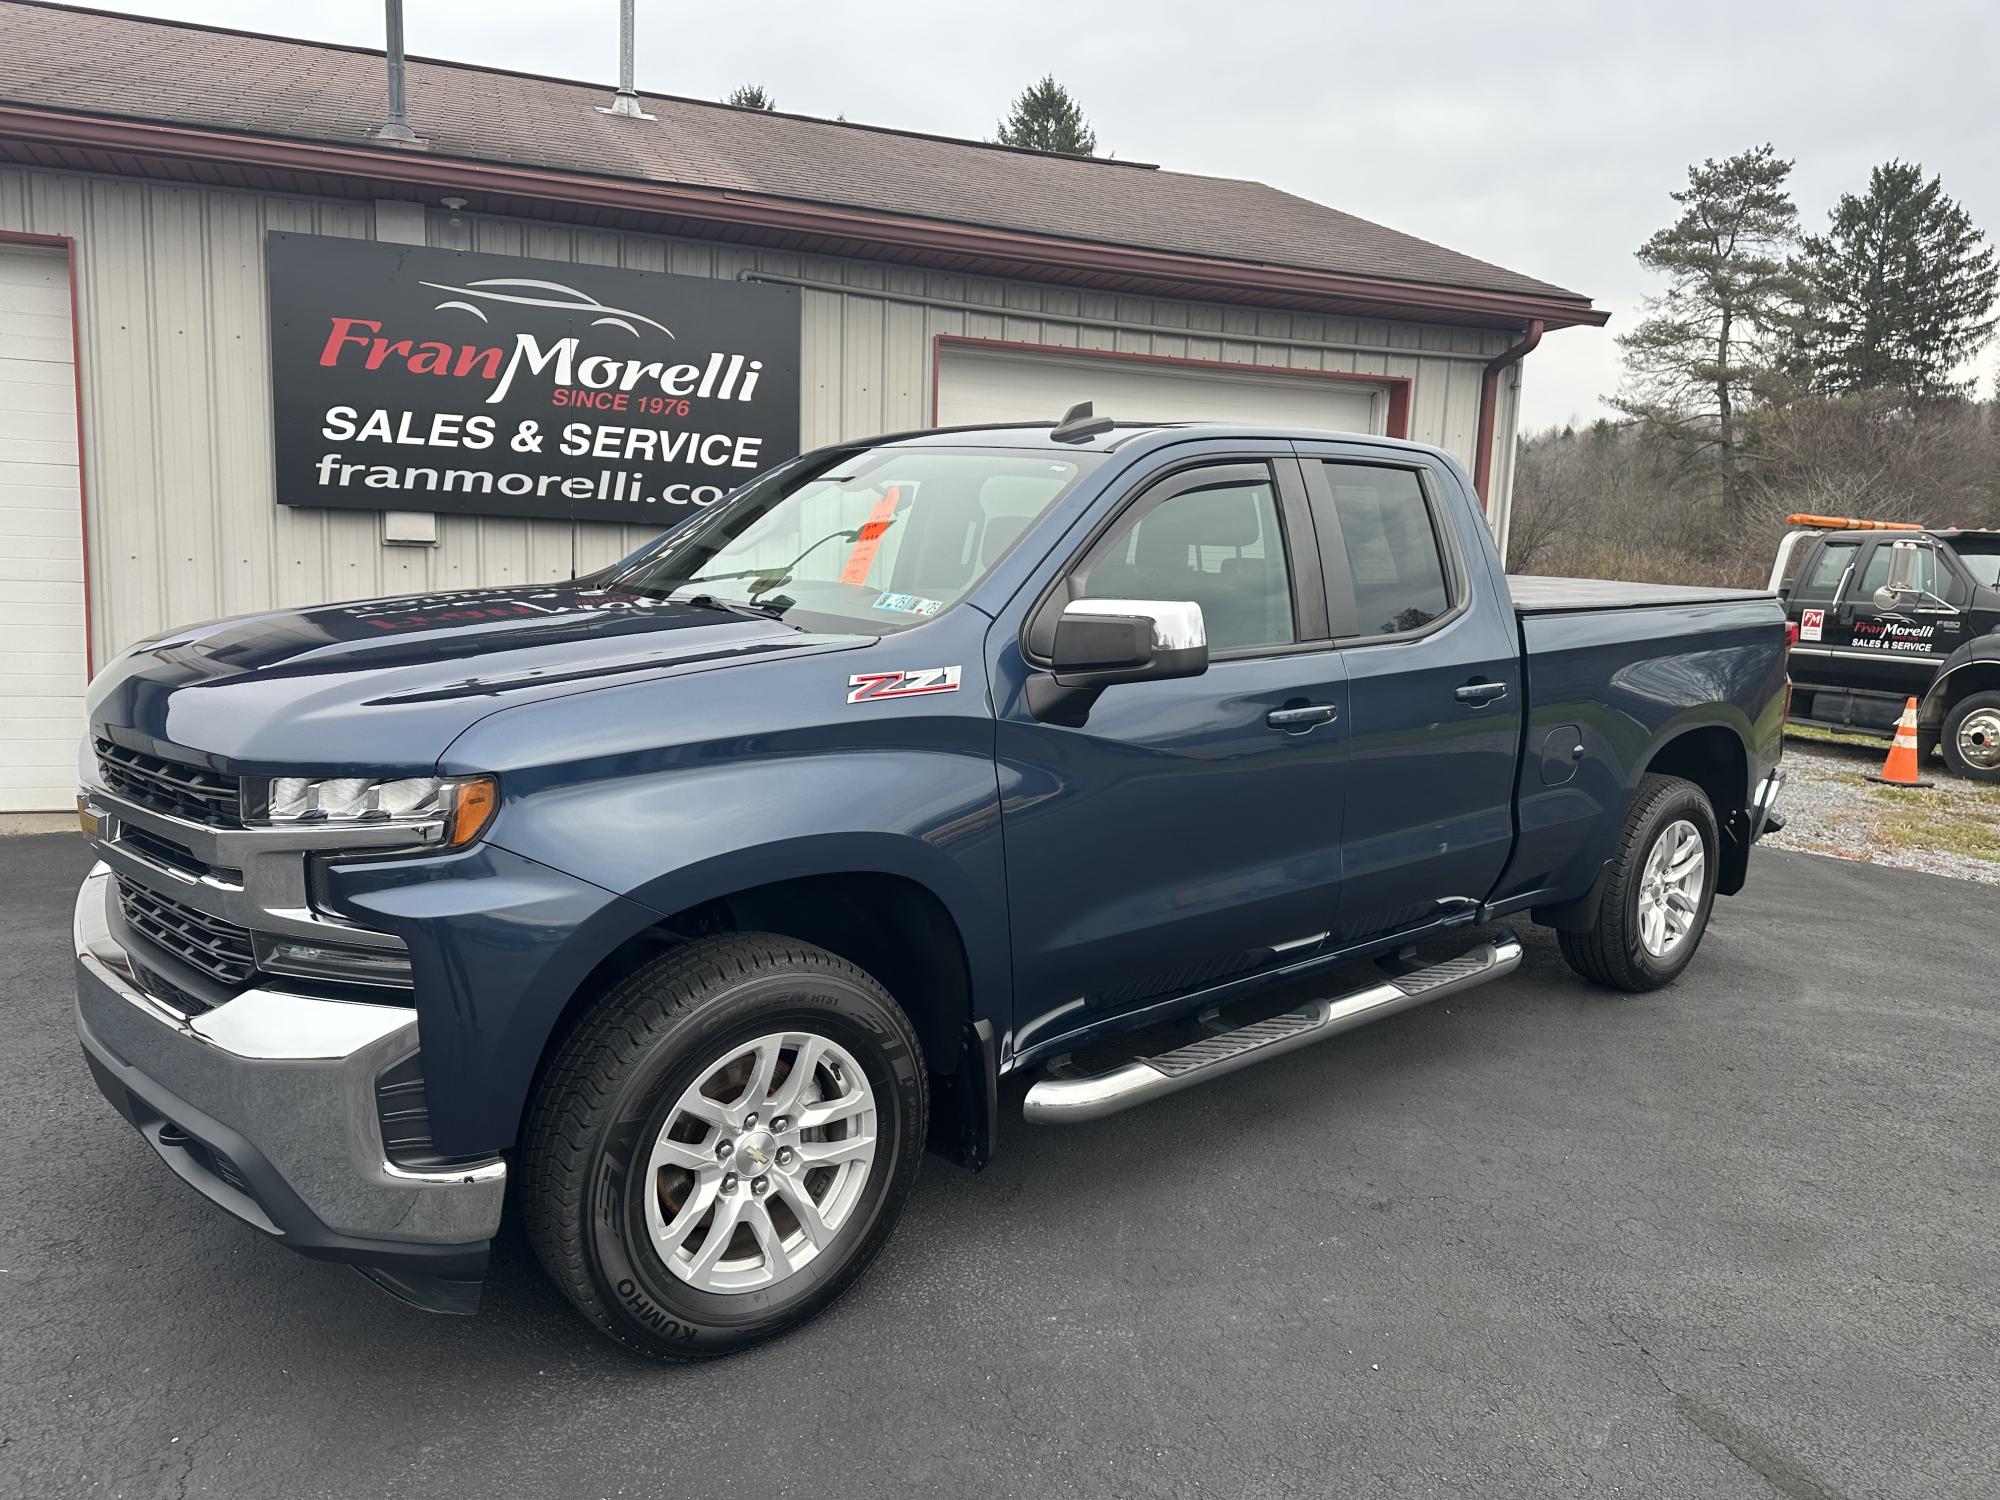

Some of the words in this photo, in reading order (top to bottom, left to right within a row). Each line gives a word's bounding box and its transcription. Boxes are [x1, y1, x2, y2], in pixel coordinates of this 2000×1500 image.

[552, 388, 630, 412] SINCE
[638, 396, 691, 417] 1976
[322, 405, 497, 450] SALES
[510, 419, 544, 453] &
[559, 422, 763, 468] SERVICE
[315, 453, 739, 507] franmorelli.co
[1852, 638, 1882, 649] SALES
[1882, 640, 1889, 649] &
[1891, 640, 1932, 652] SERVICE
[847, 665, 962, 704] Z71
[616, 1278, 698, 1343] KUMHO
